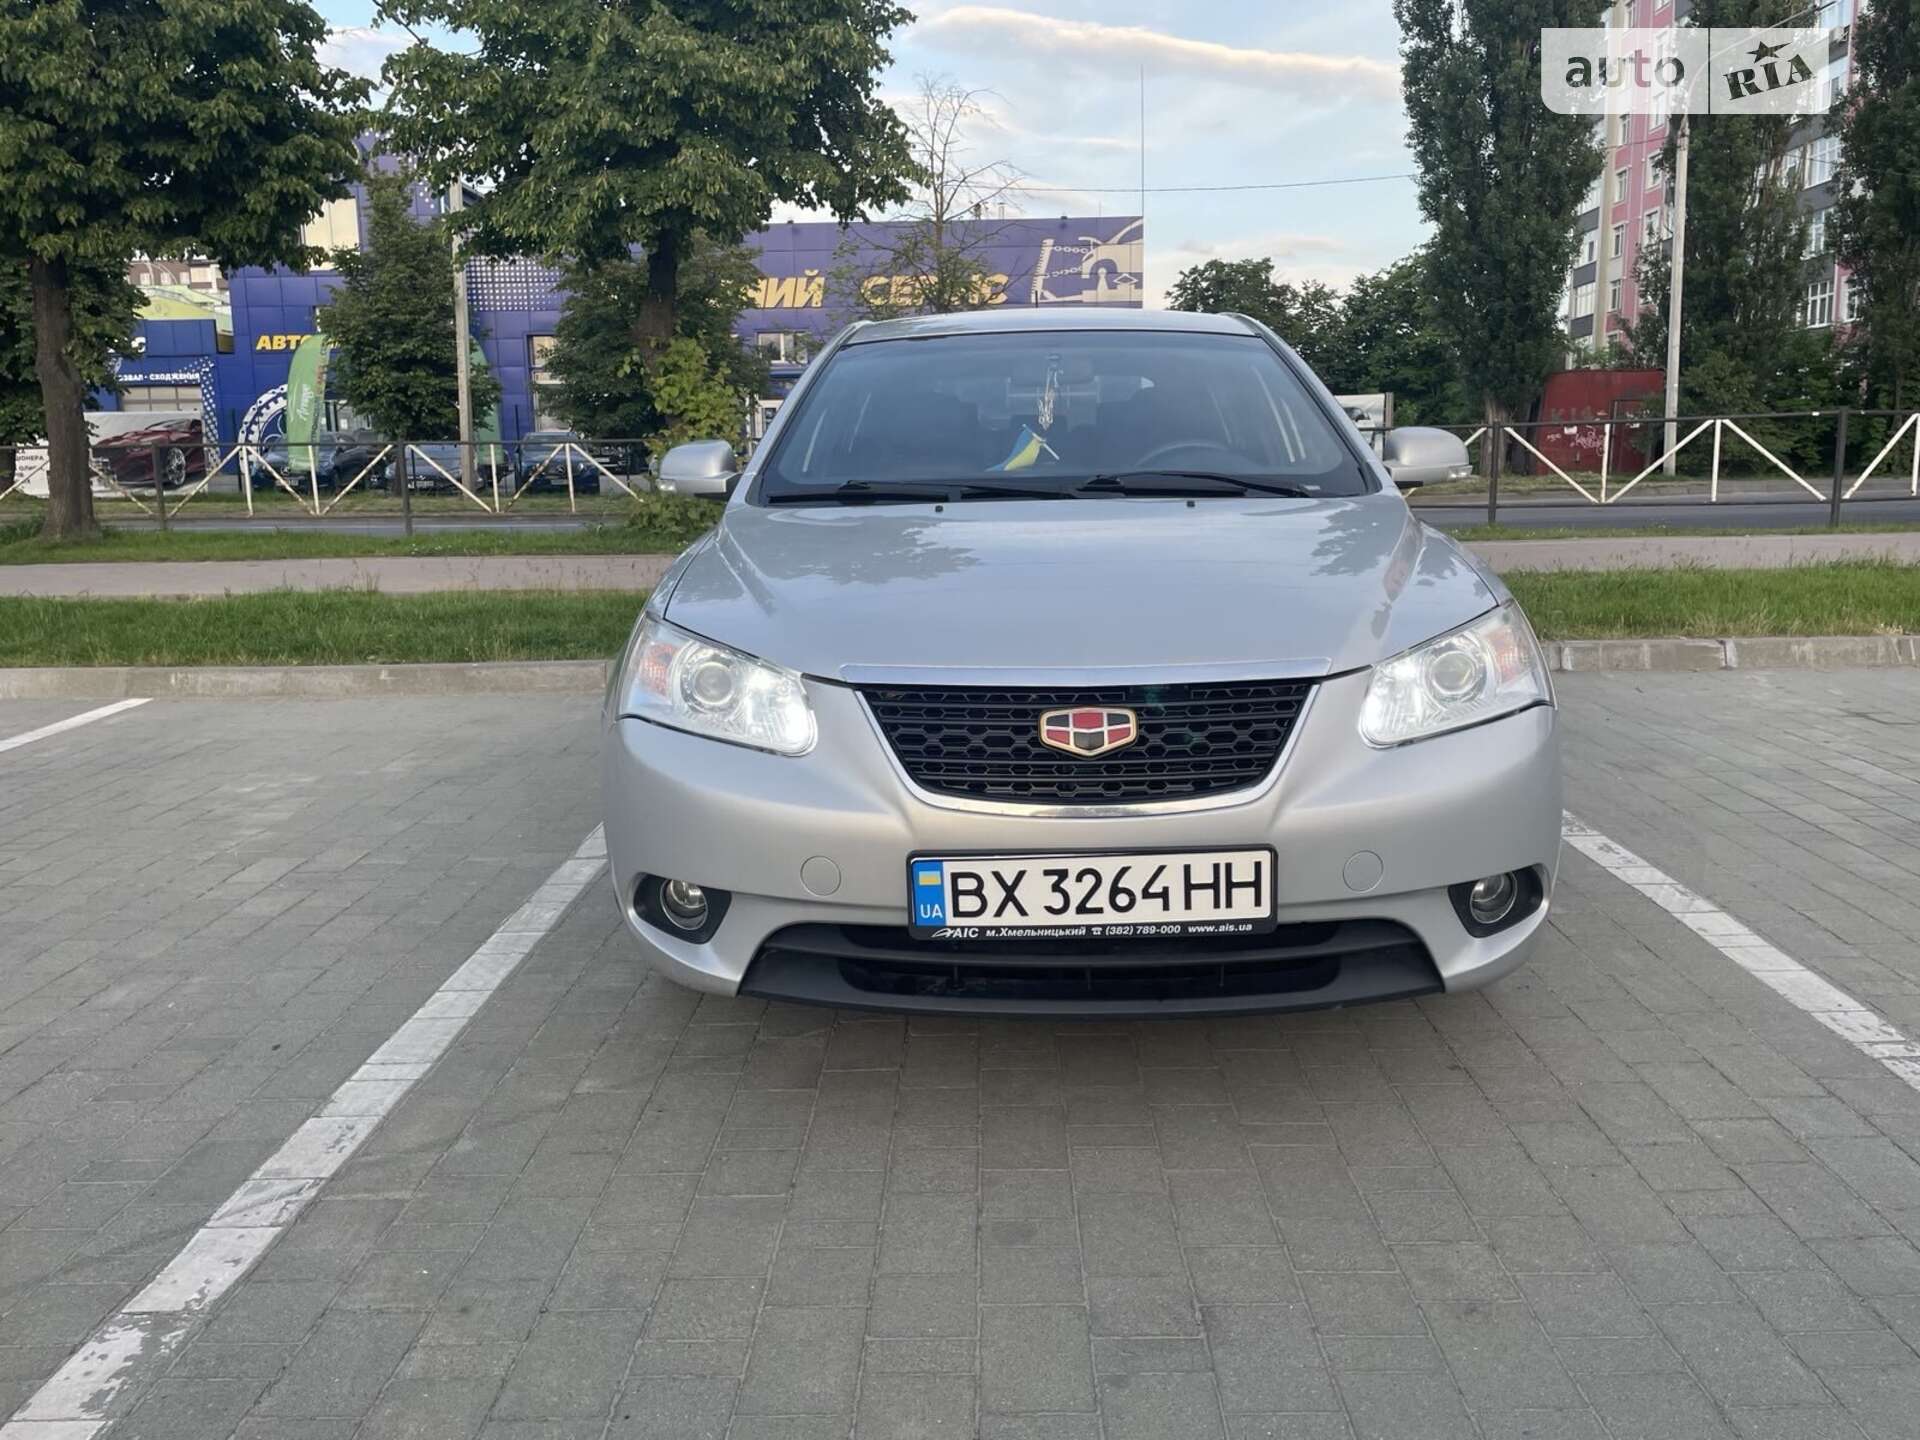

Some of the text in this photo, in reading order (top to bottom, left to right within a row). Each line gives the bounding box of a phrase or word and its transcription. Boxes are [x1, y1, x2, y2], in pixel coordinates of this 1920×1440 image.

[950, 860, 1262, 918] BX 3264 HH
[920, 903, 944, 919] UA
[986, 926, 1086, 938] м.Хмельницький
[1105, 925, 1134, 936] (382)
[1137, 924, 1181, 935] 789-000
[1188, 923, 1252, 933] www.ais.ua
